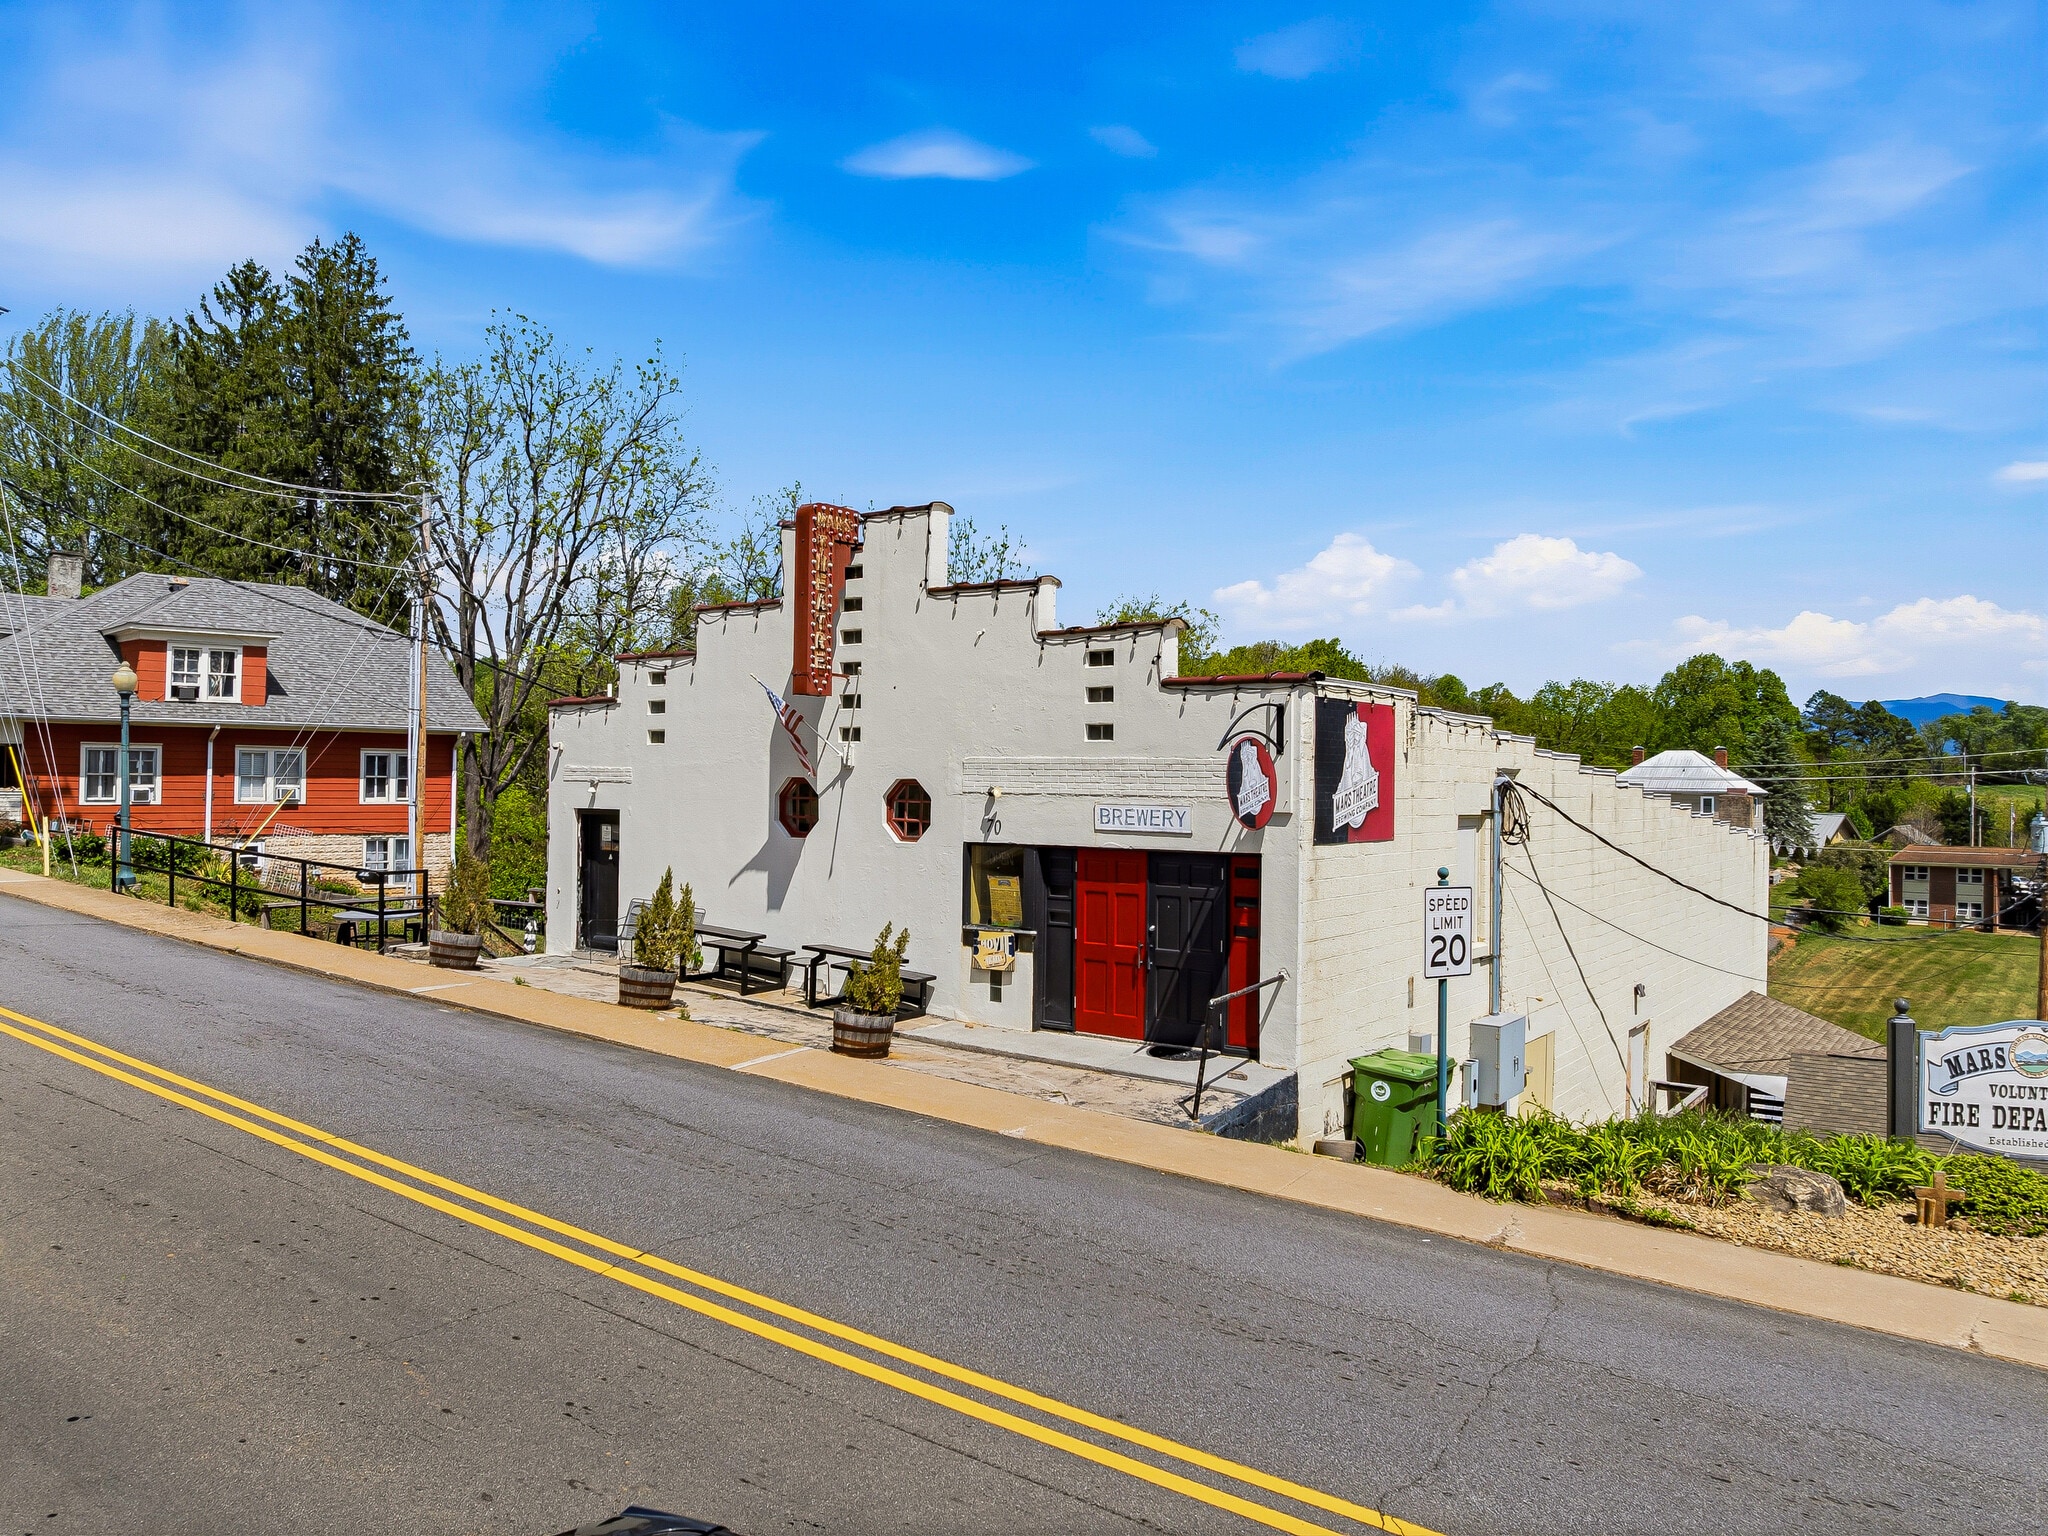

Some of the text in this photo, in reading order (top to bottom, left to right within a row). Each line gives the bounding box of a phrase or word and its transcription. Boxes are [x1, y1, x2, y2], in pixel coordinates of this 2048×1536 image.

[817, 512, 853, 532] MARS
[814, 533, 829, 669] THEATRE
[1335, 778, 1377, 814] MARS THEATRE
[986, 818, 1002, 836] 70
[1099, 807, 1187, 828] BREWERY
[1428, 897, 1469, 912] SPEED
[1433, 916, 1463, 930] LIMIT
[1430, 934, 1467, 968] 20
[1944, 1046, 2006, 1079] MARS
[1989, 1084, 2048, 1101] VOLUNT
[1928, 1101, 2048, 1132] FIRE DEPA
